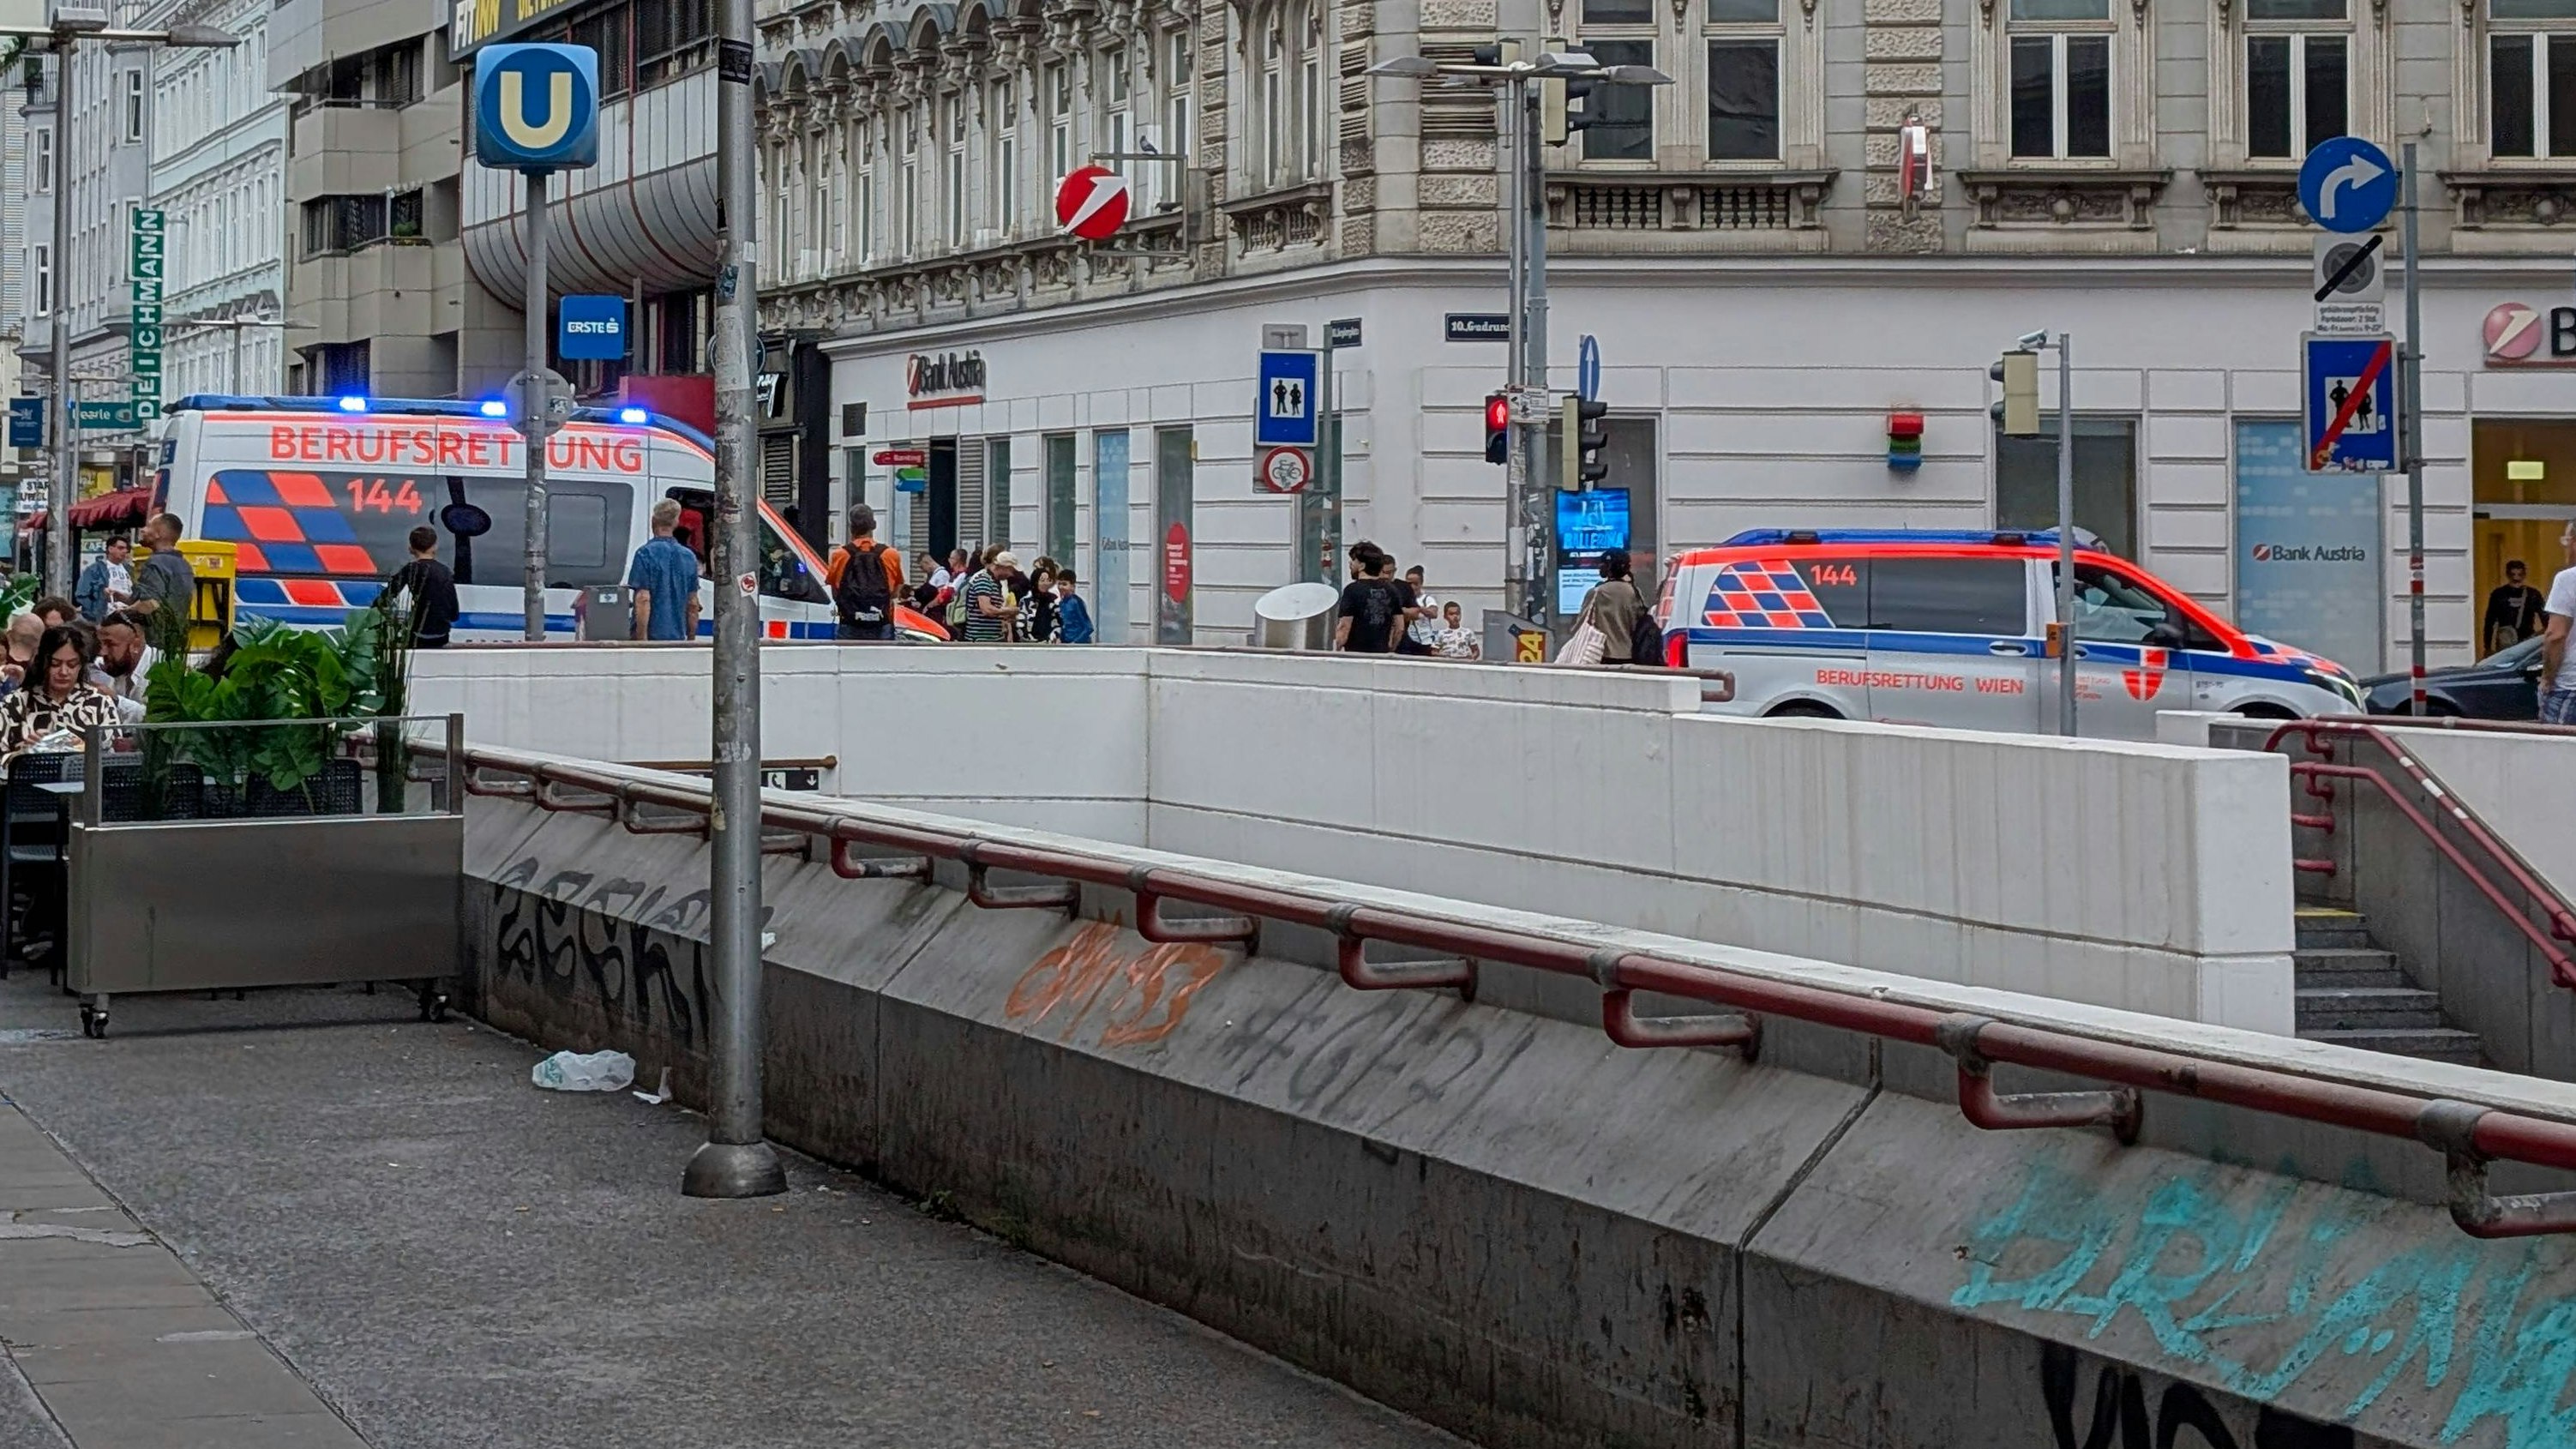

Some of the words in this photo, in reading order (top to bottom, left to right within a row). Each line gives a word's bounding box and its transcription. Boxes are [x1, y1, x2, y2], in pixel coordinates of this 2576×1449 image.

[500, 70, 573, 149] U
[137, 212, 159, 419] DEICHMANN
[567, 322, 605, 334] ERSTE
[920, 352, 946, 394] Bank
[947, 350, 986, 389] Austria
[271, 425, 643, 472] BERUFSRETUNG
[347, 478, 423, 514] 144
[2272, 545, 2311, 562] Bank
[2315, 545, 2366, 562] Austria
[1810, 564, 1858, 586] 144
[1816, 670, 1964, 691] BERUFSRETTUNG
[1975, 677, 2024, 694] WIEN
